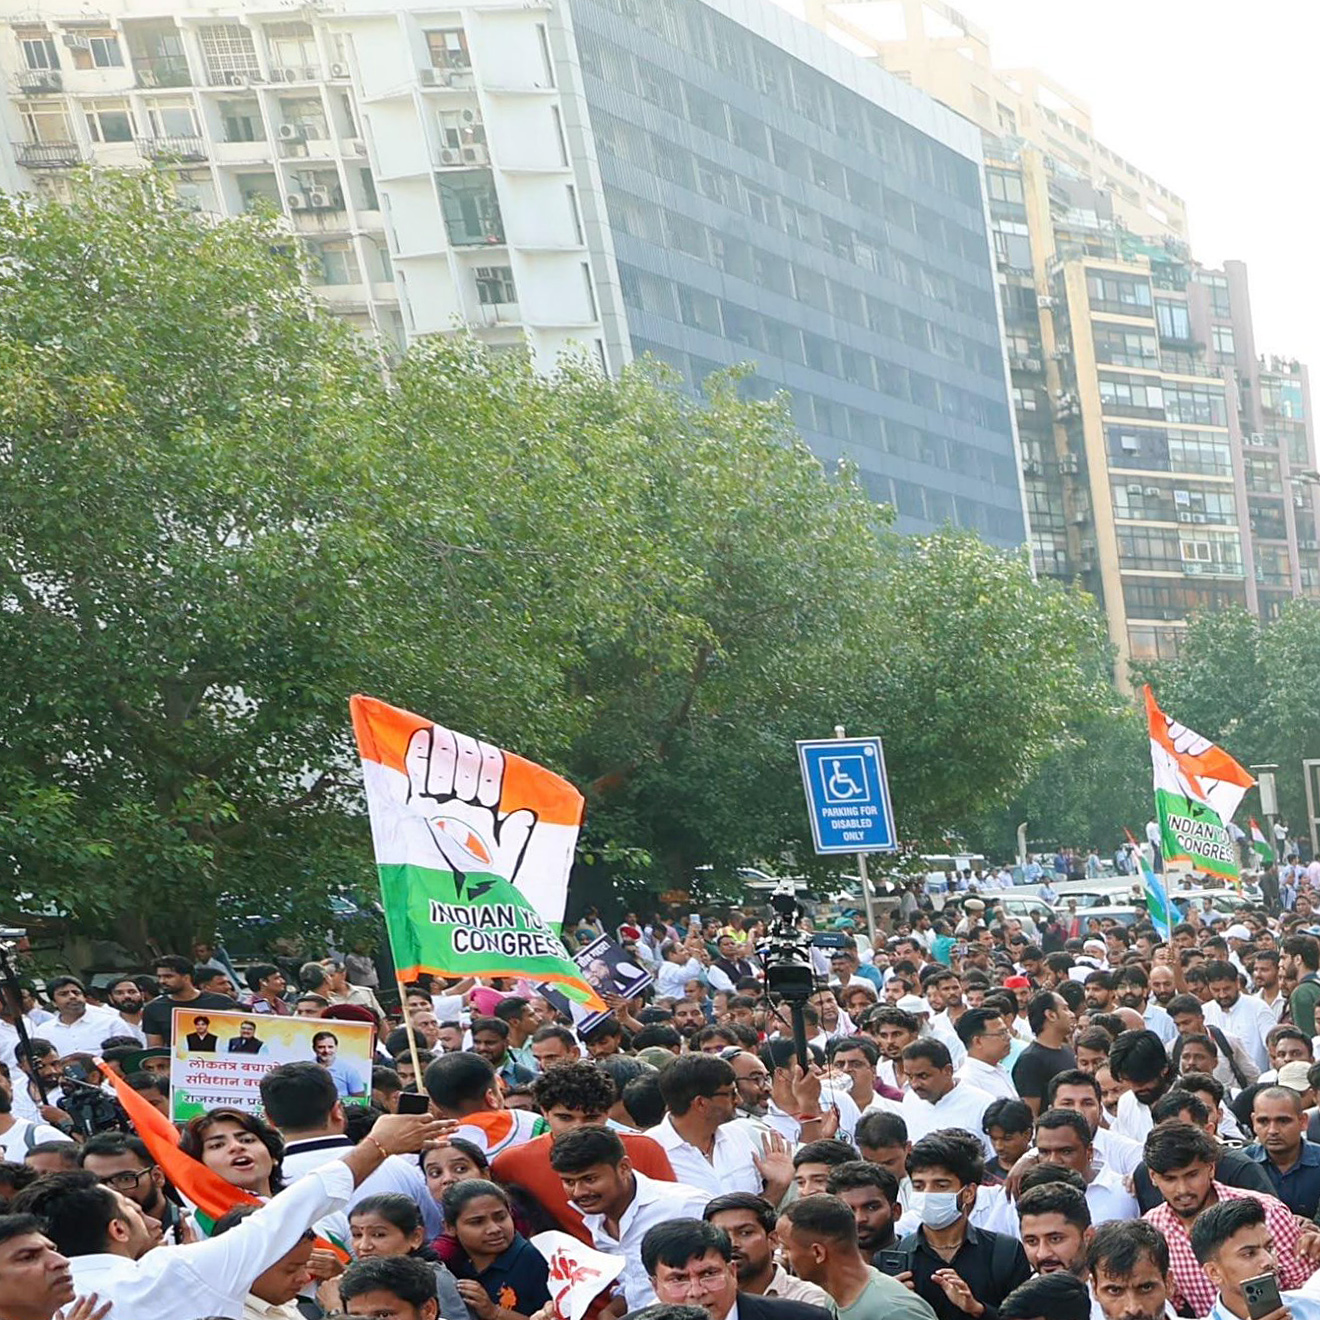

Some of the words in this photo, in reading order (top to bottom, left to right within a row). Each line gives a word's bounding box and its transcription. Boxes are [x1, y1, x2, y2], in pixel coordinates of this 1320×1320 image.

[822, 807, 859, 817] PARKING
[860, 806, 878, 816] FOR
[831, 819, 873, 829] DISABLED
[1168, 815, 1214, 839] INDIAN
[843, 832, 864, 841] ONLY
[430, 900, 515, 929] INDIAN
[189, 1057, 237, 1071] लोकतंत्र
[185, 1072, 240, 1086] संविधान
[182, 1095, 243, 1105] राजस्थान
